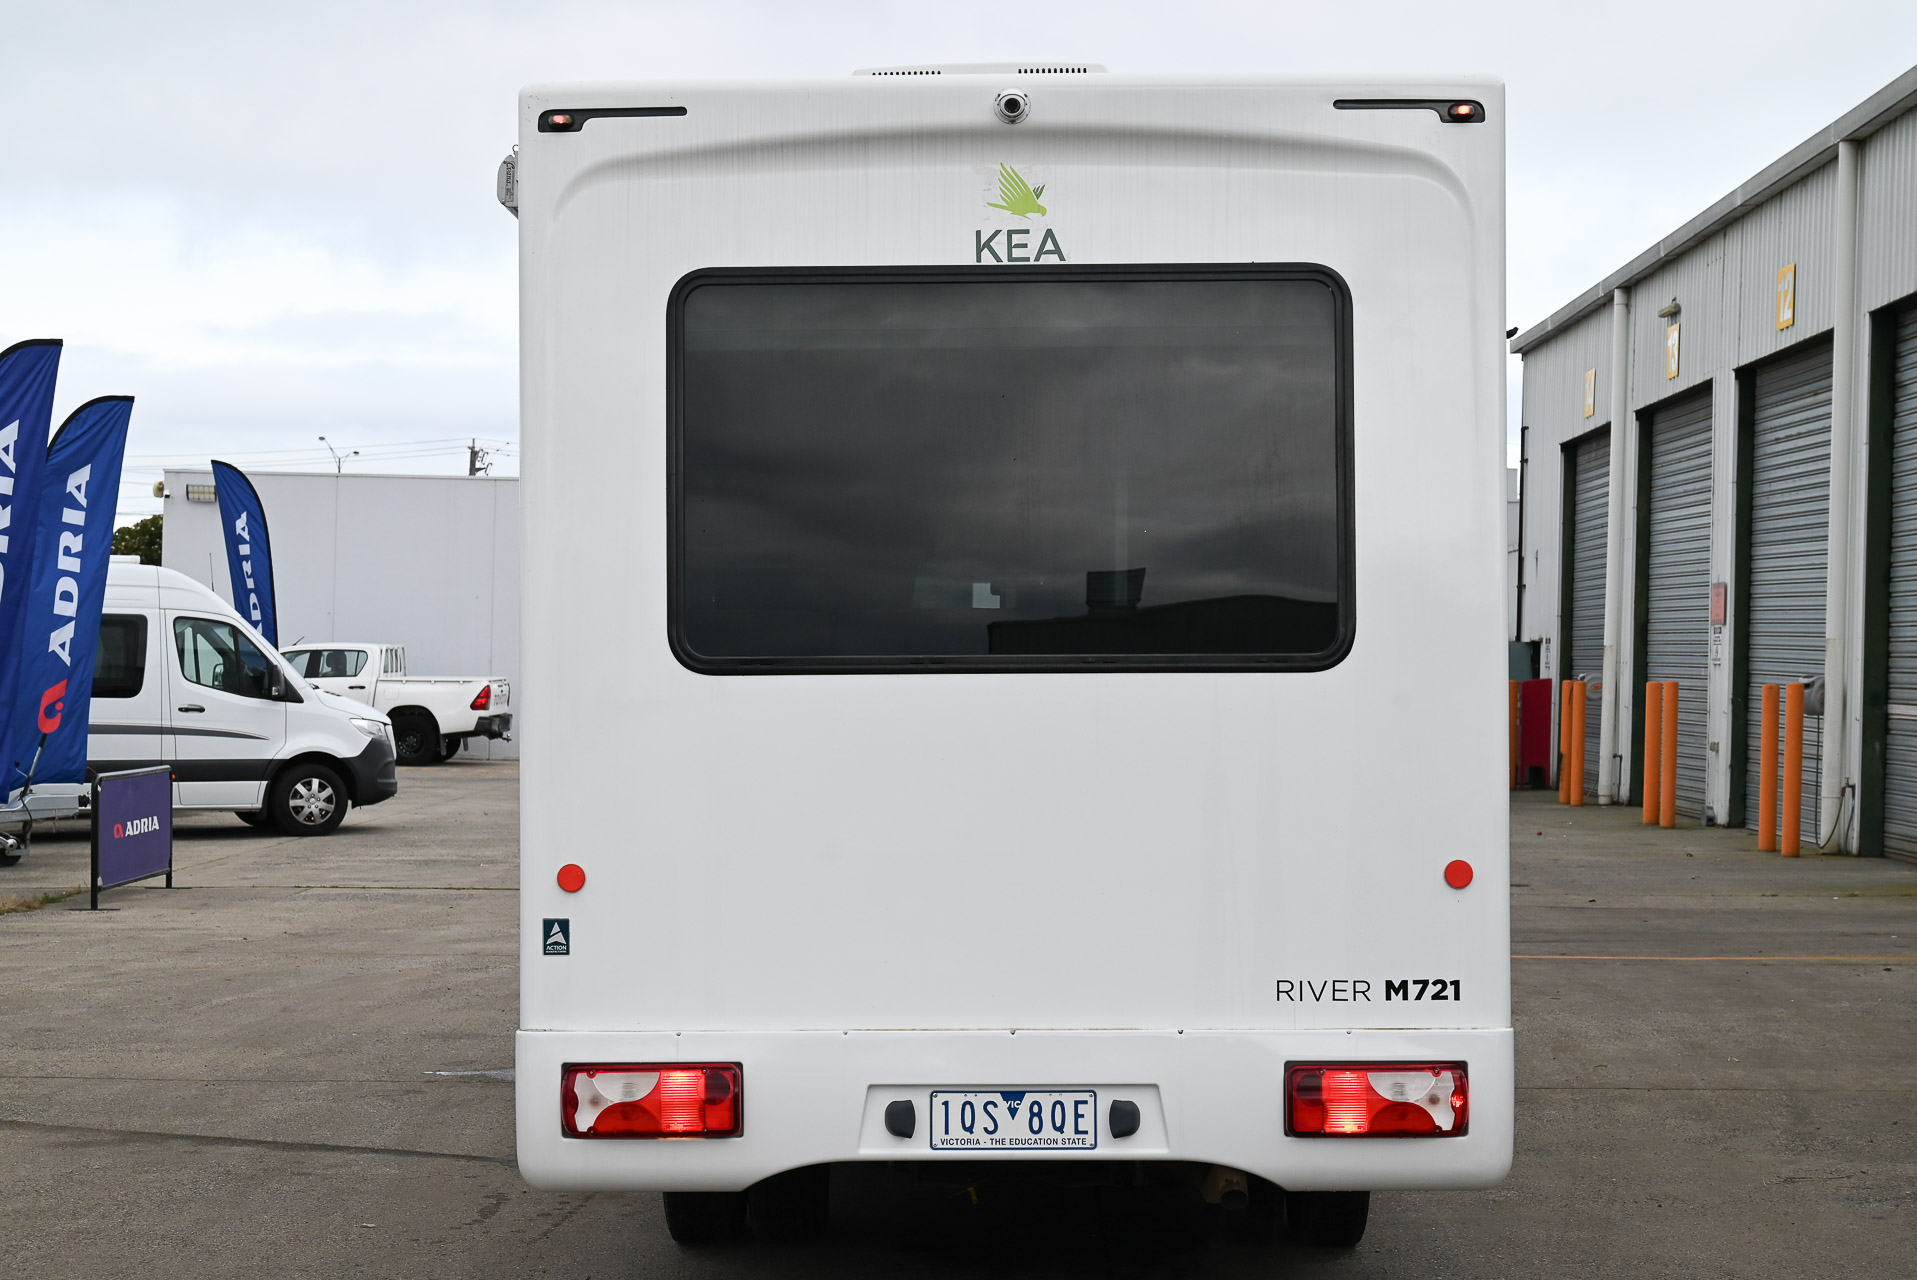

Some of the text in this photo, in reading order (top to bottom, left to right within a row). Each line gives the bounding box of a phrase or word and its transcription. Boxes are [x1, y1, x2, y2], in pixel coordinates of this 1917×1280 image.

[976, 228, 1066, 263] KEA
[1779, 272, 1793, 323] 12
[1668, 330, 1679, 373] 13
[48, 464, 92, 667] ADRIA
[125, 815, 160, 837] ADRIA
[1276, 979, 1461, 1002] RIVER M721
[941, 1099, 1089, 1136] 1QS 8QE
[1006, 1101, 1021, 1109] VIC
[940, 1137, 981, 1146] VICTORIA
[990, 1137, 1007, 1146] THE
[1009, 1137, 1059, 1146] EDUCATION
[1061, 1137, 1087, 1146] STATE
